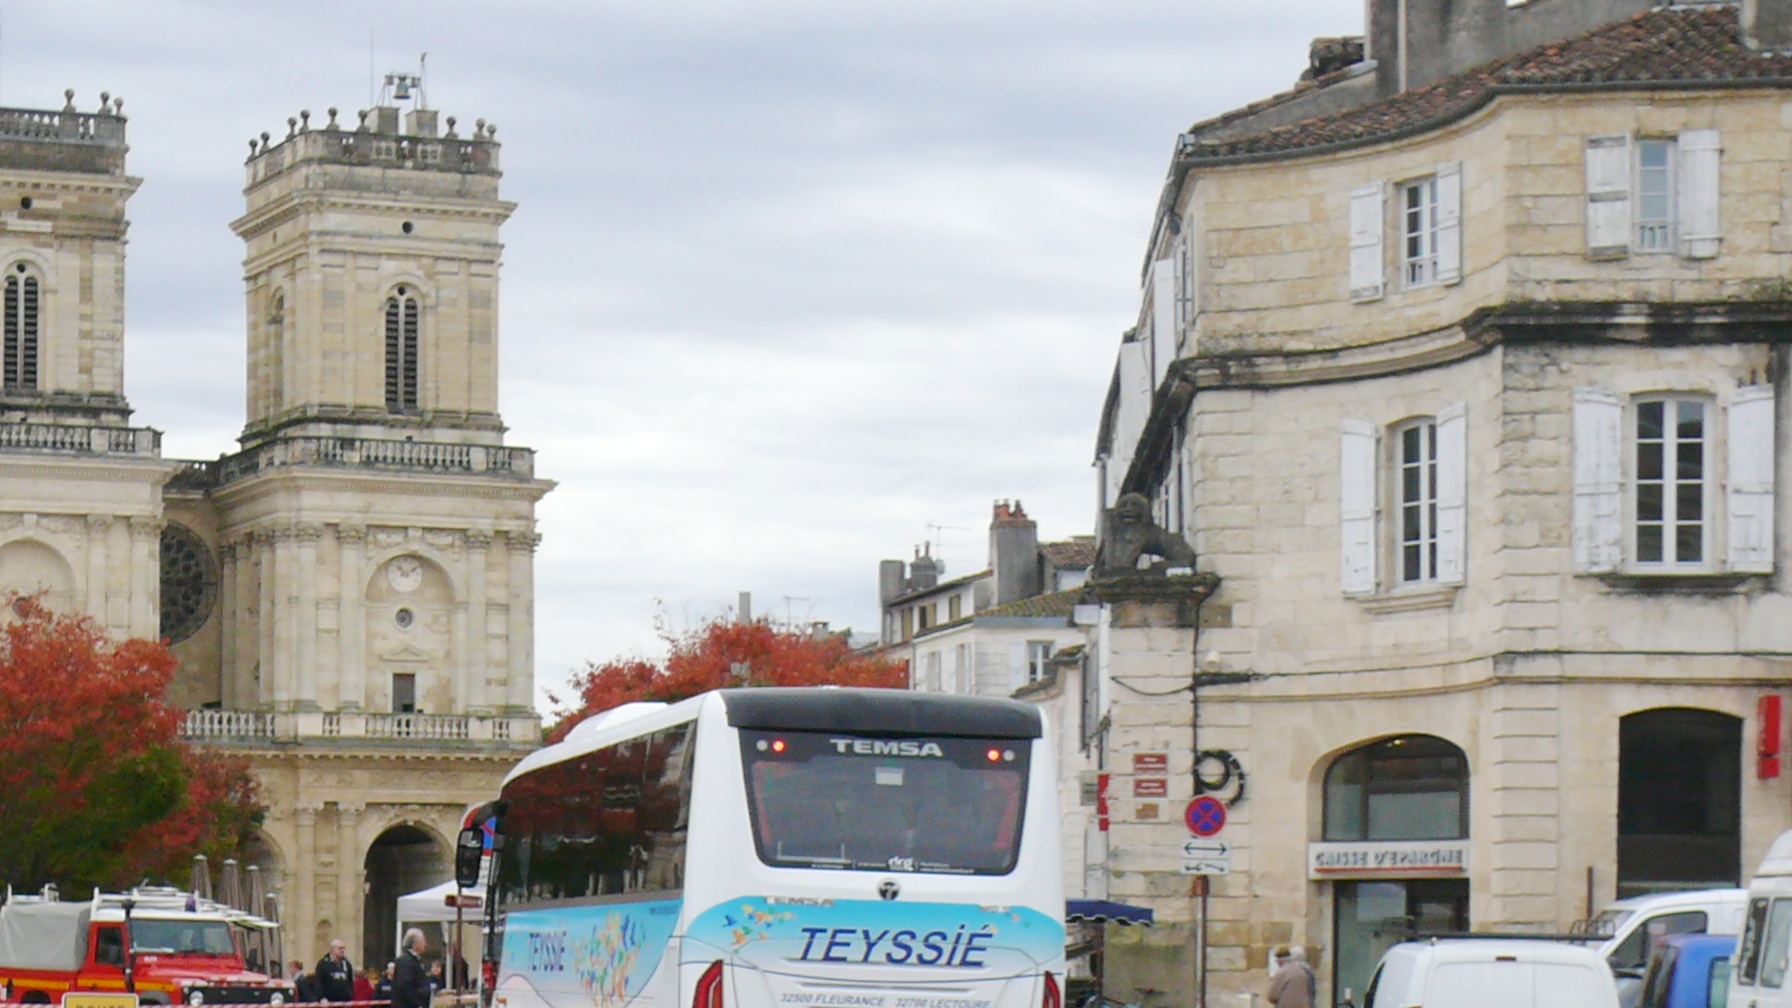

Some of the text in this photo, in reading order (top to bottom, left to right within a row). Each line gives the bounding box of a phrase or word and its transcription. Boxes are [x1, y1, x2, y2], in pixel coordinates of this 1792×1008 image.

[829, 738, 944, 757] TEMSA
[780, 992, 814, 1004] 32500
[814, 993, 886, 1008] FLEURANCE
[894, 997, 928, 1008] 32700
